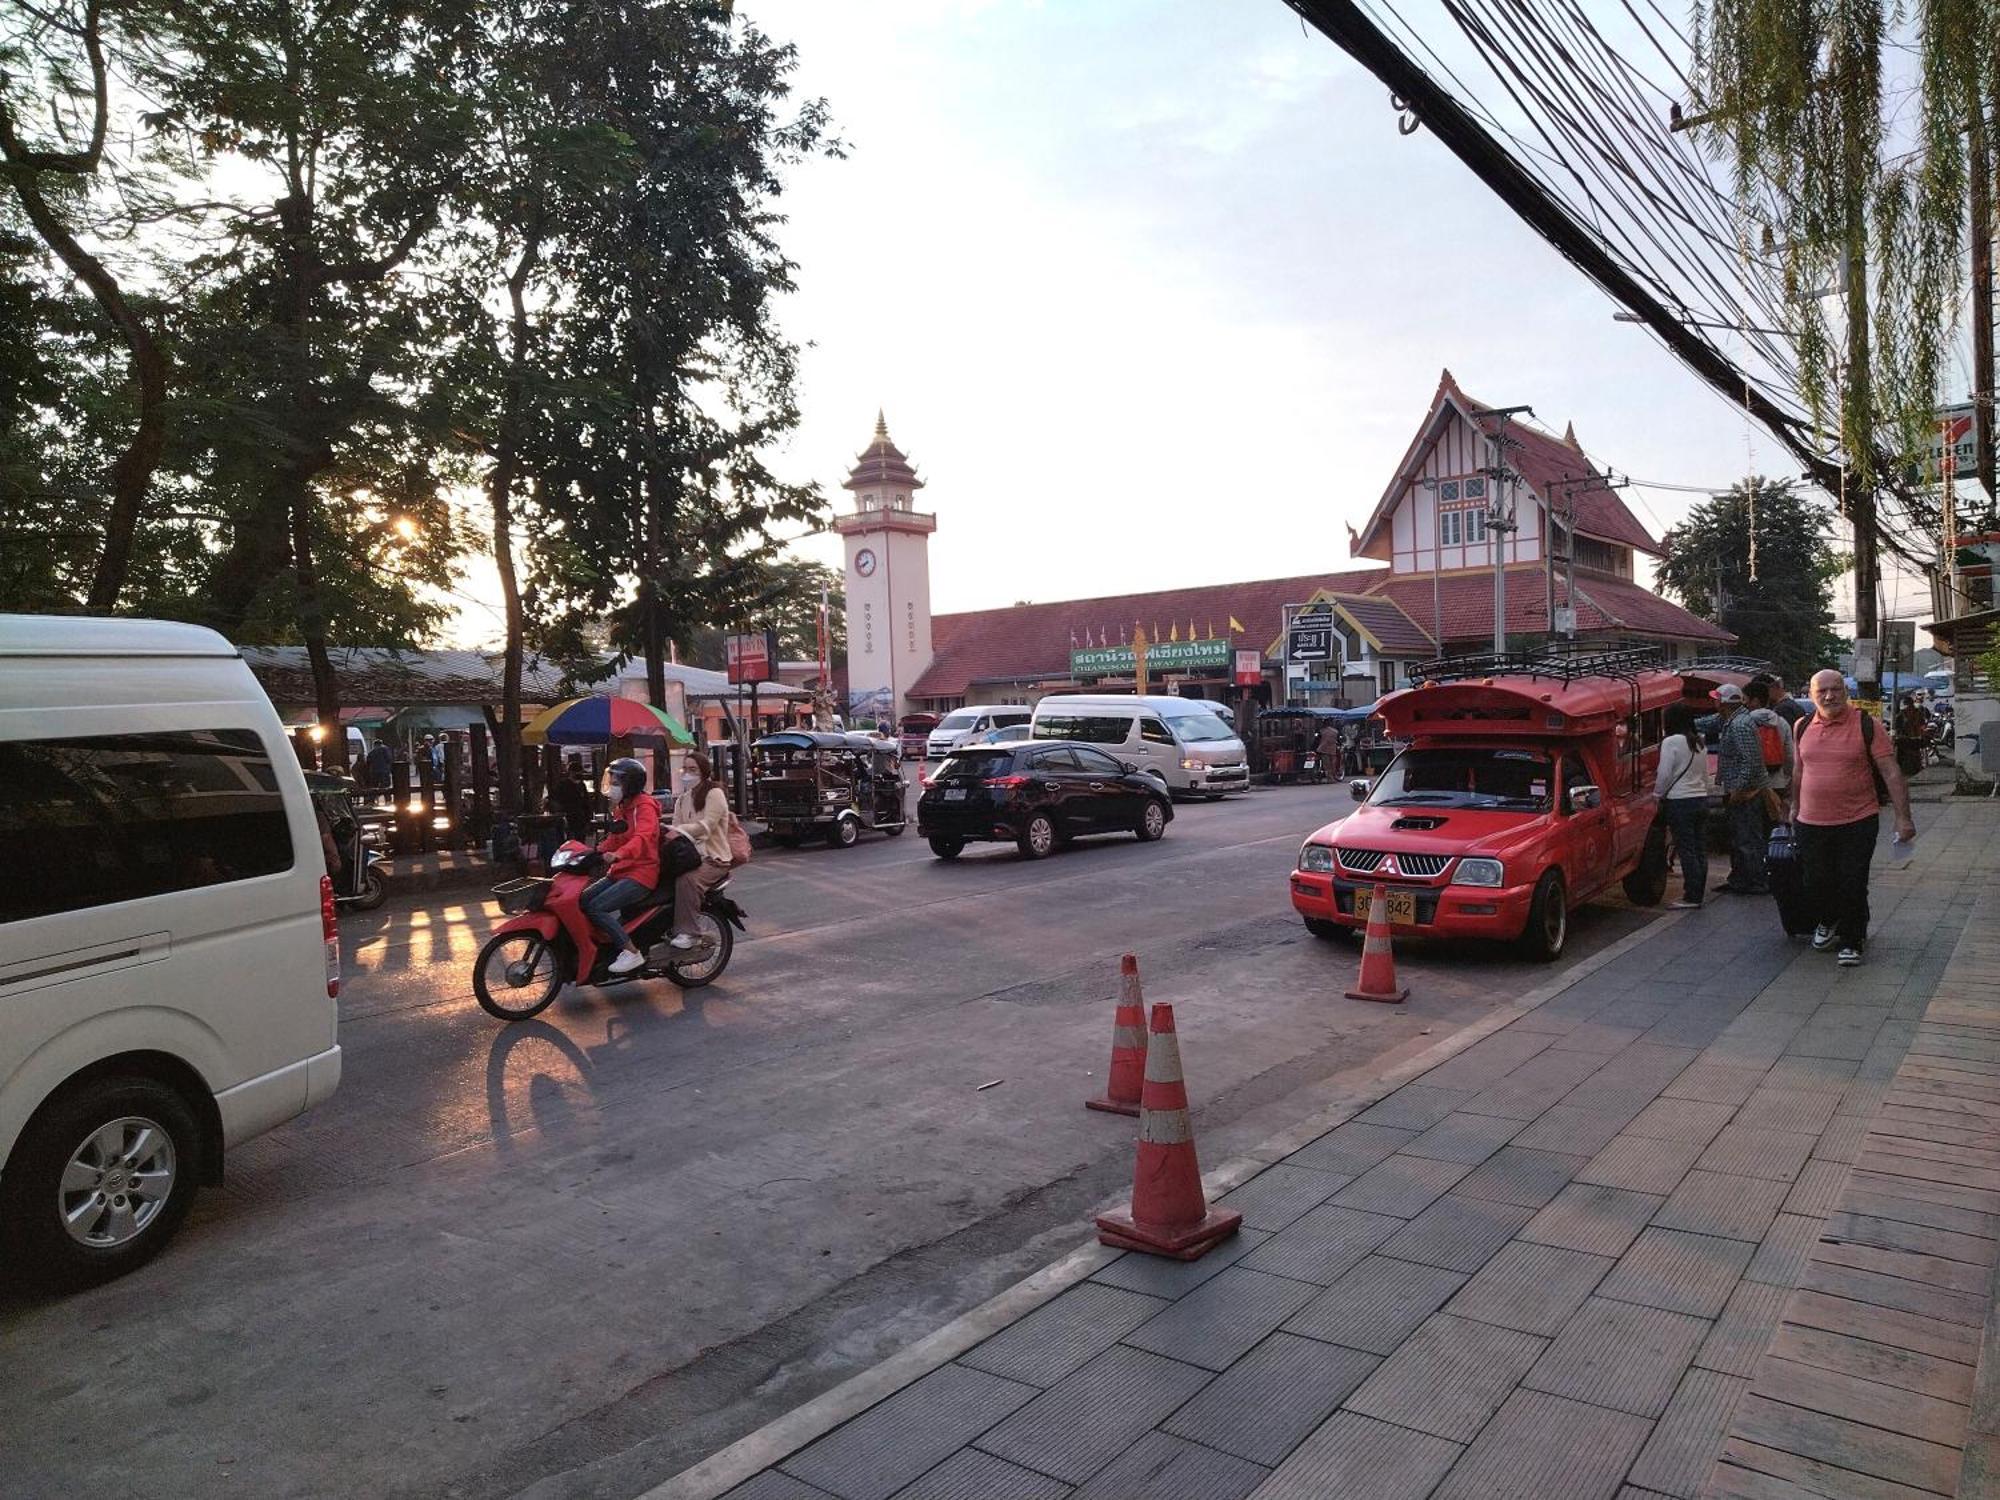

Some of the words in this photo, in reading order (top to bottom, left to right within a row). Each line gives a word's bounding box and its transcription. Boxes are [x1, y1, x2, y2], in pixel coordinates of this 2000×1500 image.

[1928, 416, 1972, 446] 7
[1320, 632, 1325, 647] 1
[1075, 641, 1226, 664] สถานีรถฟเชียงใหม่
[1180, 657, 1225, 665] STATION
